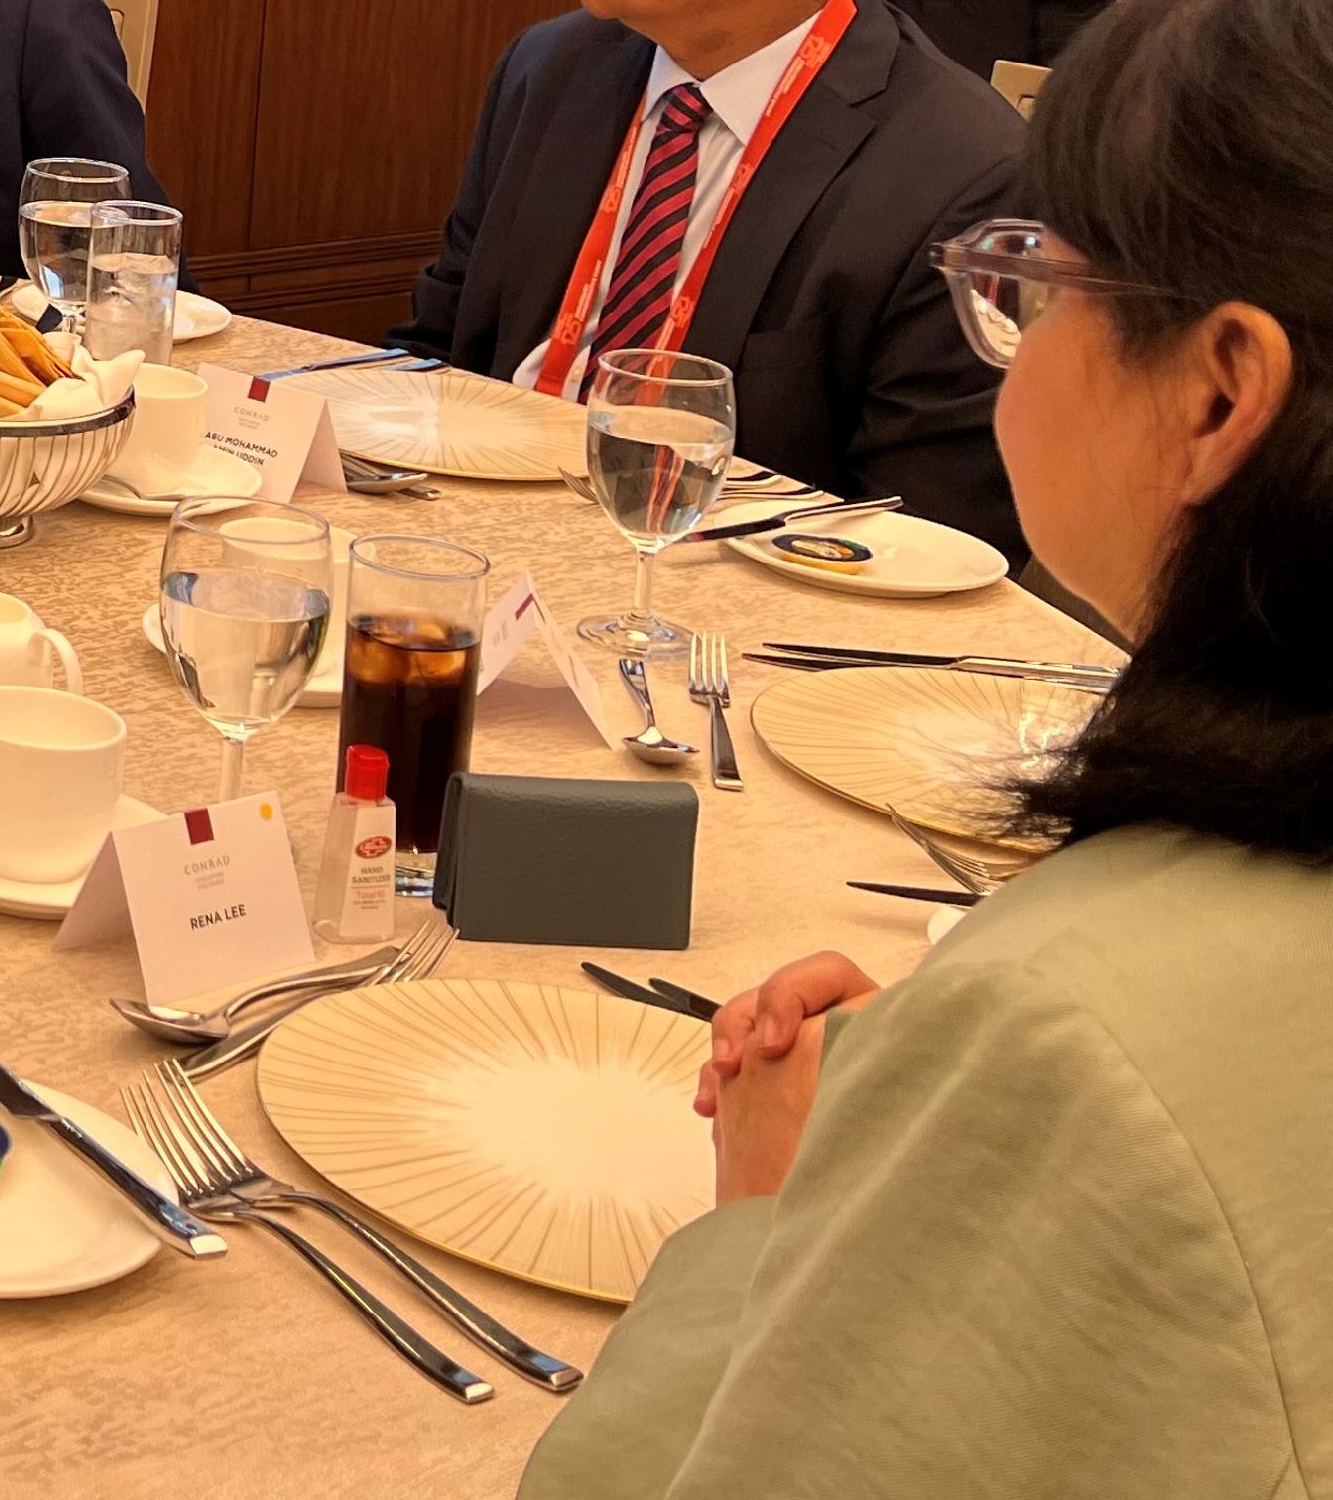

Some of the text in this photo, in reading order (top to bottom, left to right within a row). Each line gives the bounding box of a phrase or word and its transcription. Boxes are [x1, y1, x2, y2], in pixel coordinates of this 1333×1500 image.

[205, 431, 224, 442] ABU
[225, 437, 278, 458] MOHAMMAD
[184, 855, 230, 875] CONRAD
[360, 866, 384, 875] HAND
[190, 903, 247, 931] RENA LEE
